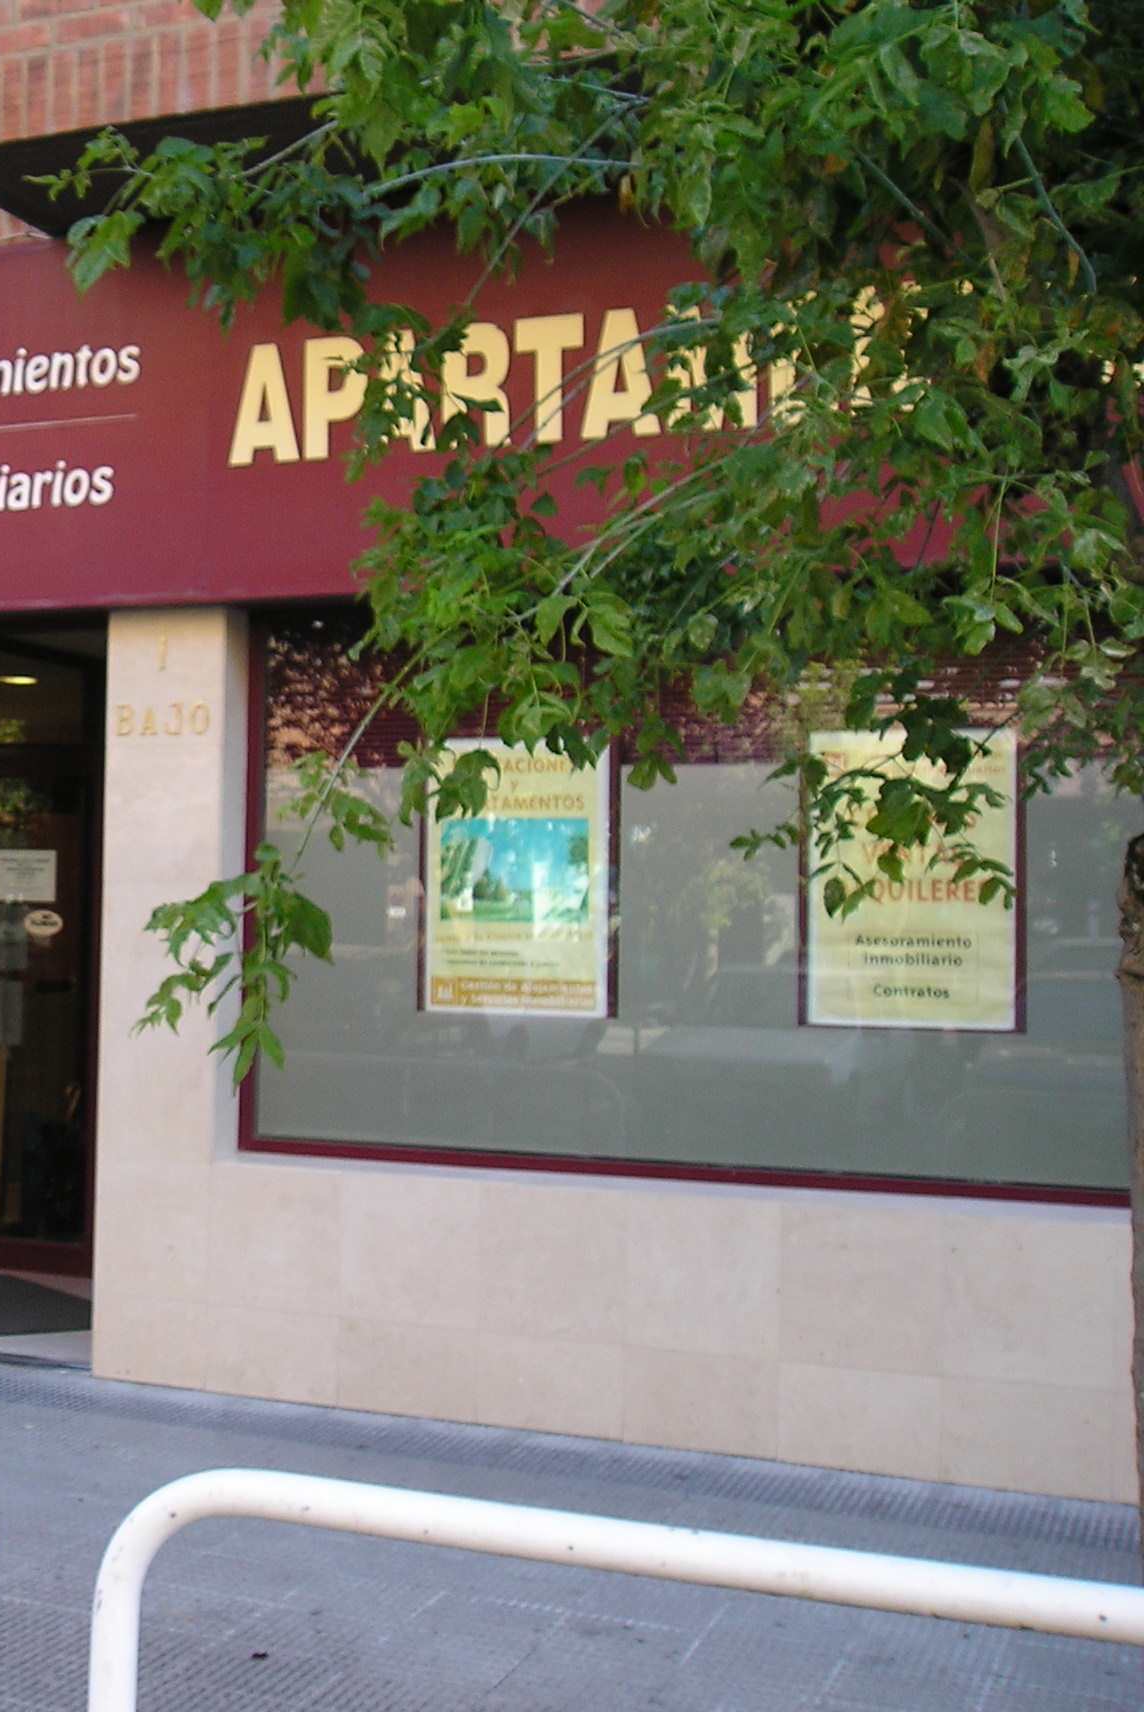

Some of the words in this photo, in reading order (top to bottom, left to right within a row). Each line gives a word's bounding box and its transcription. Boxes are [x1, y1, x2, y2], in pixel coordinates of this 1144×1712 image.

[115, 701, 212, 736] BAJO
[855, 934, 973, 949] Asesoramiento
[873, 983, 951, 1000] Contratos
